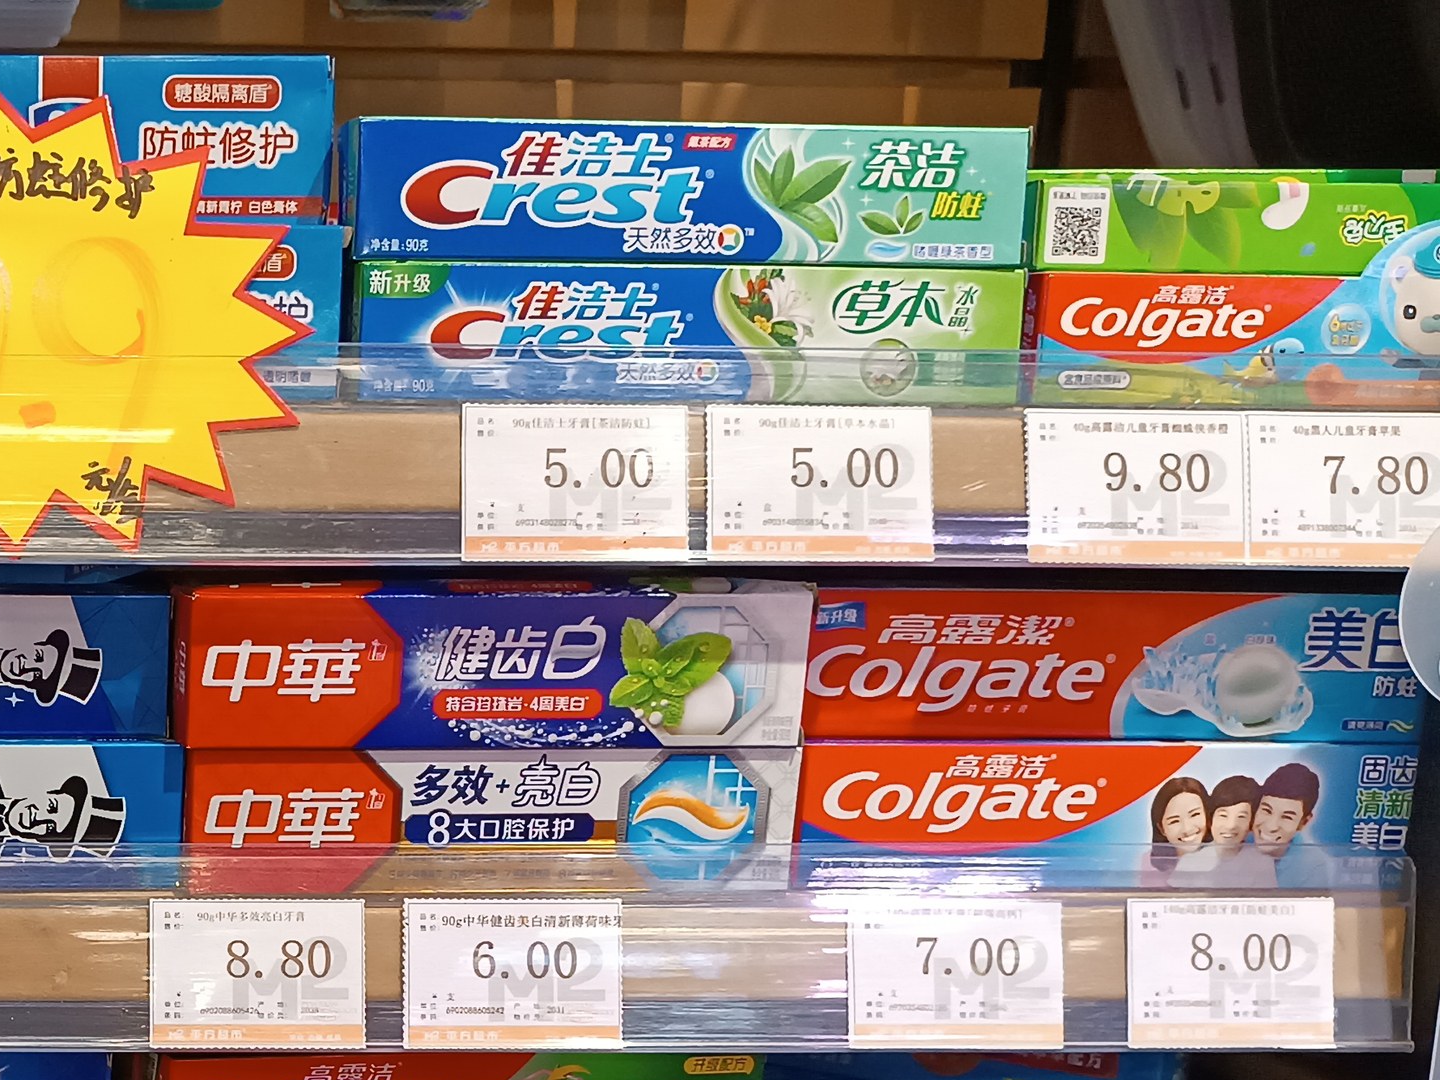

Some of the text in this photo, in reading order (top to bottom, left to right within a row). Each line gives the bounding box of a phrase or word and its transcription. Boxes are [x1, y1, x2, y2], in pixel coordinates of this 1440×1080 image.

[505, 131, 671, 179] 佳洁士
[859, 140, 966, 190] 茶洁
[401, 160, 713, 230] Crest
[929, 191, 986, 219] 防蛀
[627, 226, 717, 251] 天然多效
[368, 268, 431, 296] 新升级
[514, 282, 661, 322] 佳洁士
[1151, 284, 1230, 306] 高露洁
[833, 279, 946, 336] 草本
[948, 285, 976, 329] 水晶
[1059, 296, 1266, 348] Colgate
[428, 308, 688, 361] Crest
[544, 447, 654, 489] 5.00
[790, 447, 899, 489] 5.00
[1102, 450, 1211, 494] 9.80
[1322, 454, 1429, 496] 7.80
[435, 616, 608, 681] 健齿白
[877, 613, 1064, 646] 高露潔
[201, 638, 366, 703] 中華
[805, 644, 1107, 714] Colgate
[1372, 676, 1418, 699] 防蛀
[945, 754, 1050, 780] 高露洁
[1360, 755, 1418, 787] 固齿
[204, 788, 366, 848] 中華
[821, 770, 1099, 834] Colgate
[1354, 788, 1414, 819] 清新
[426, 810, 575, 846] 8大口腔保护
[1351, 822, 1408, 851] 美白
[226, 939, 332, 979] 8.80
[472, 940, 578, 979] 6.00
[915, 936, 1020, 977] 7.00
[1190, 932, 1292, 972] 8.00
